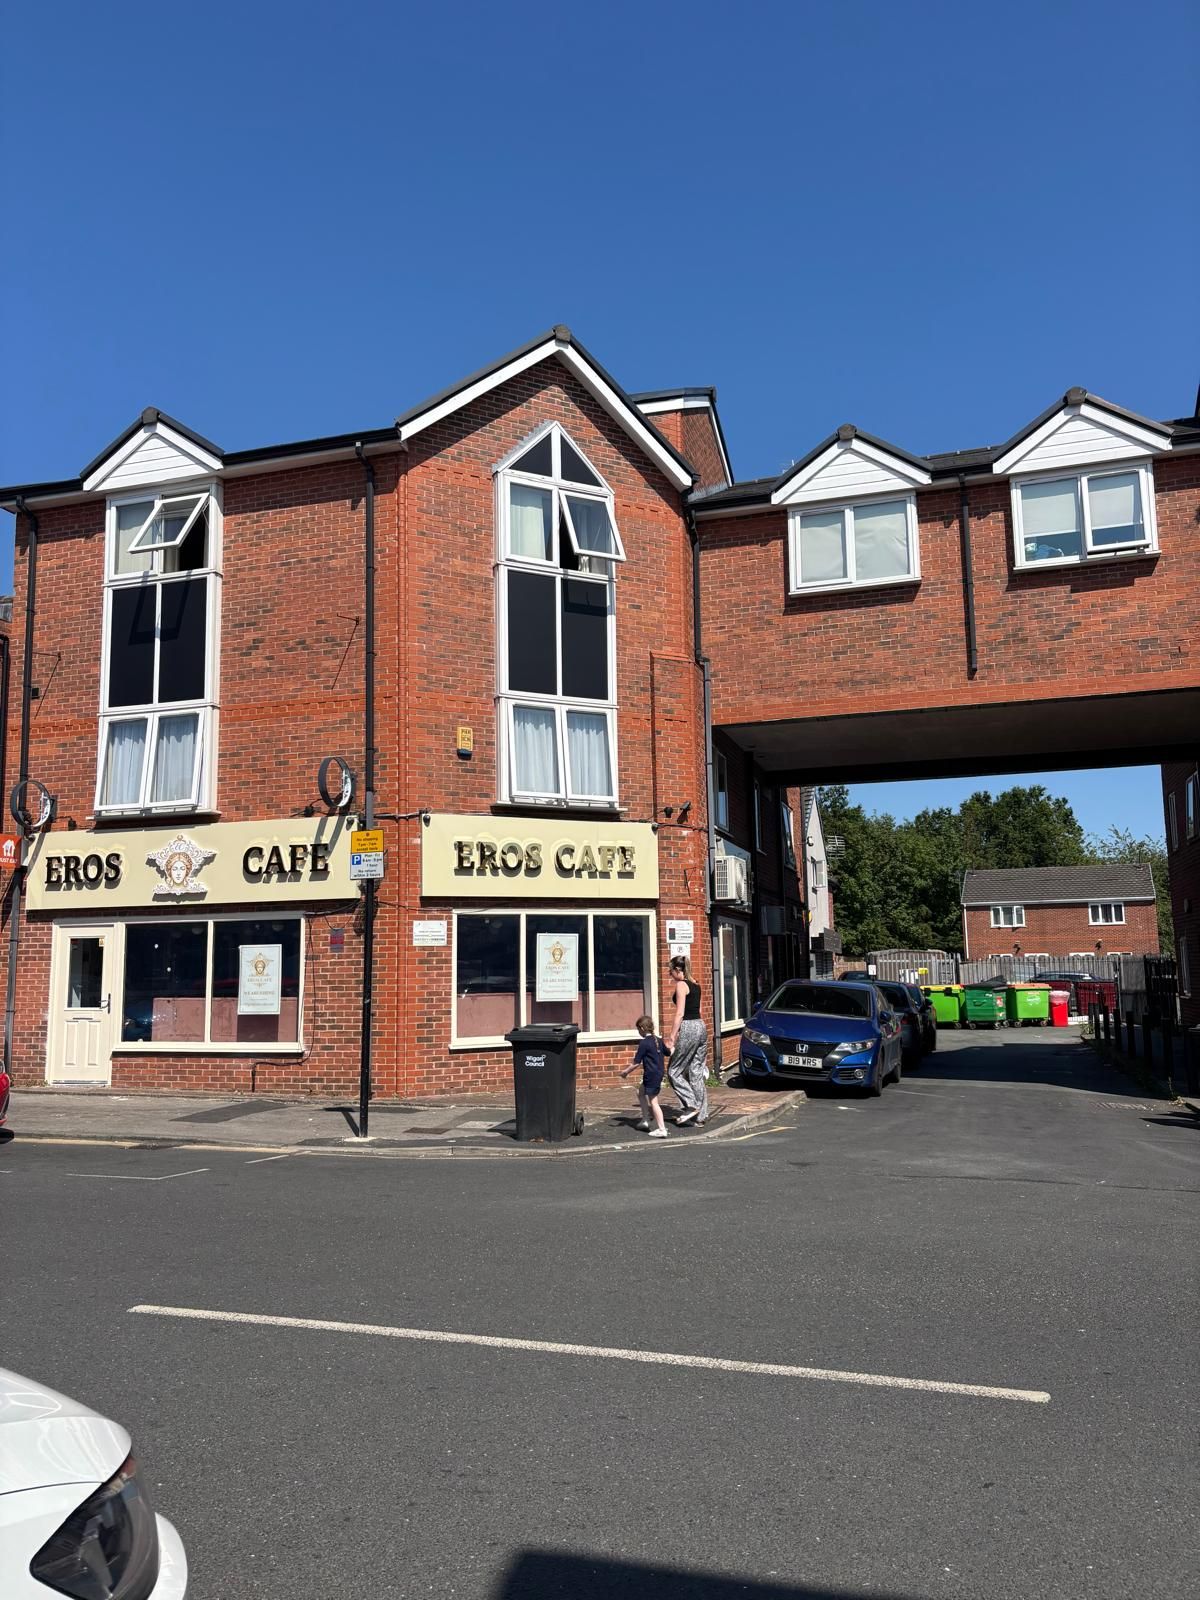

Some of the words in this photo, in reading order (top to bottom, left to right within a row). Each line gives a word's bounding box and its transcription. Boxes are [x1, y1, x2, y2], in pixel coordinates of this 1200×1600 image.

[45, 853, 121, 884] EROS
[243, 844, 330, 876] CAFE
[453, 841, 544, 870] EROS
[555, 843, 637, 873] CAFE
[802, 1057, 817, 1066] WRS
